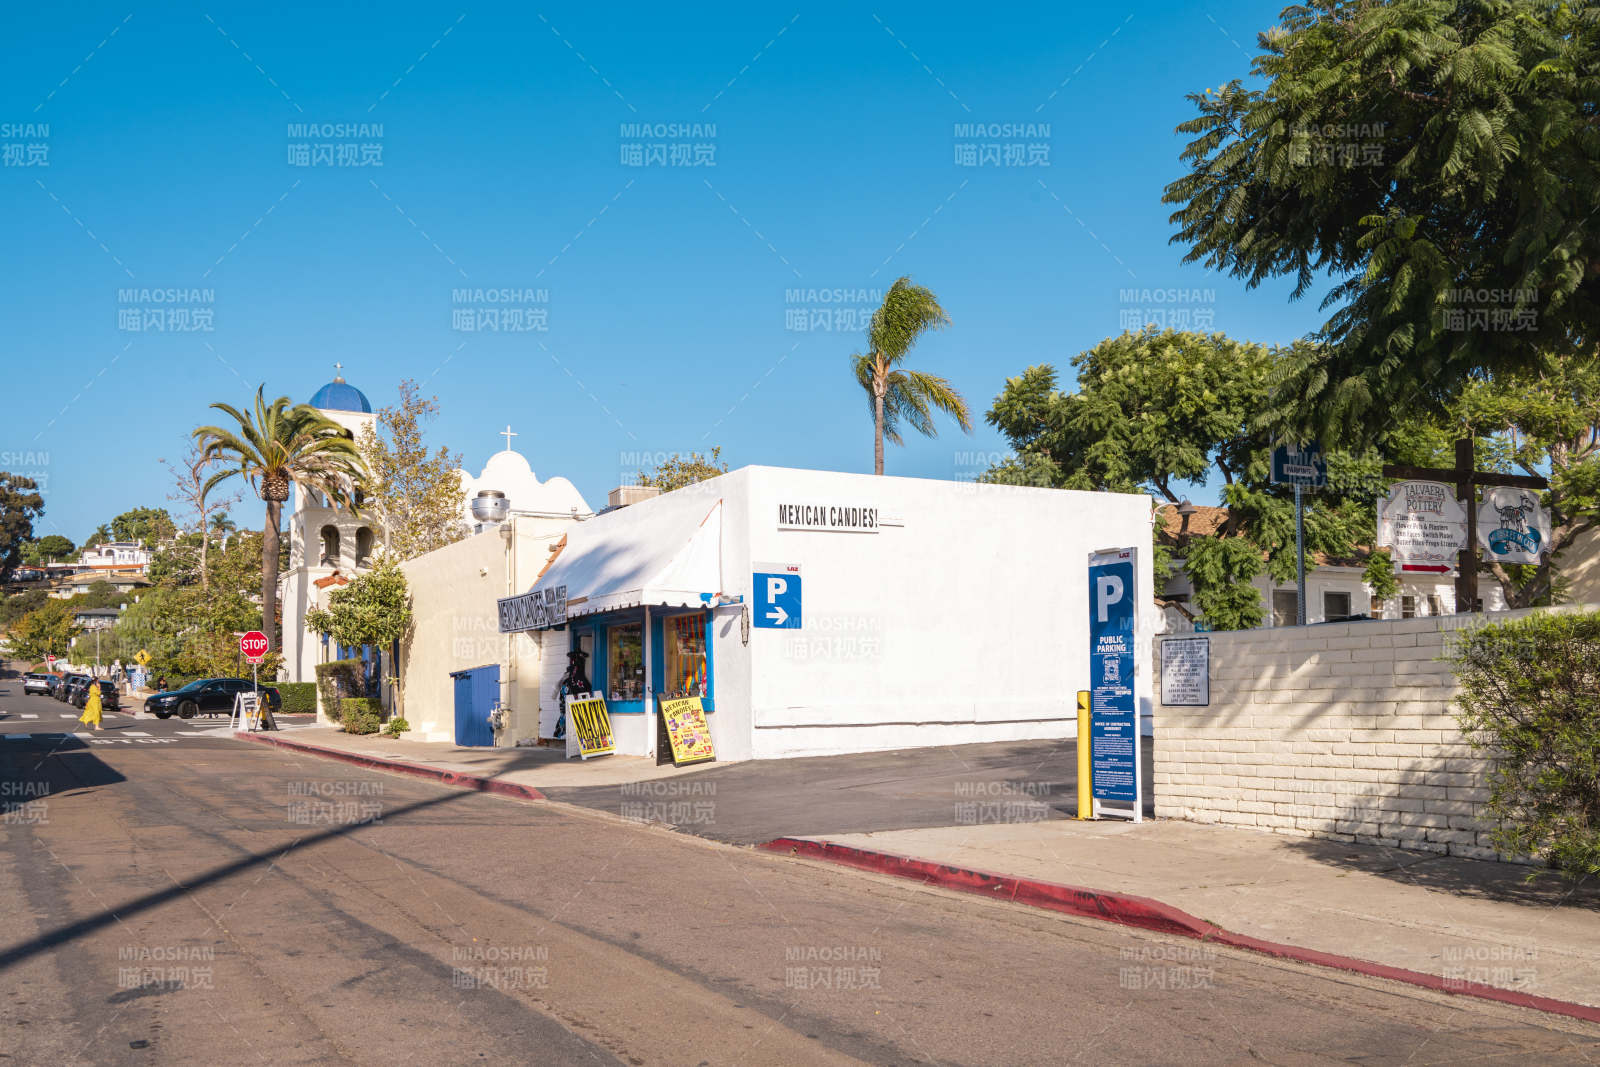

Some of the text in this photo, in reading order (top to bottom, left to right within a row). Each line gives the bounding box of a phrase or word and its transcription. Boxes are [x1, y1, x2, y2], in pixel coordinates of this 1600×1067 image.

[1407, 500, 1443, 512] POTTERY
[780, 504, 878, 528] MEXICAN CANDIES!
[767, 577, 788, 604] P
[1097, 575, 1124, 623] P
[242, 639, 266, 650] STOP
[1099, 634, 1123, 644] PUBLIC
[1097, 644, 1127, 653] PARKING
[664, 700, 689, 713] MEXICAN
[571, 700, 611, 739] SNACKS
